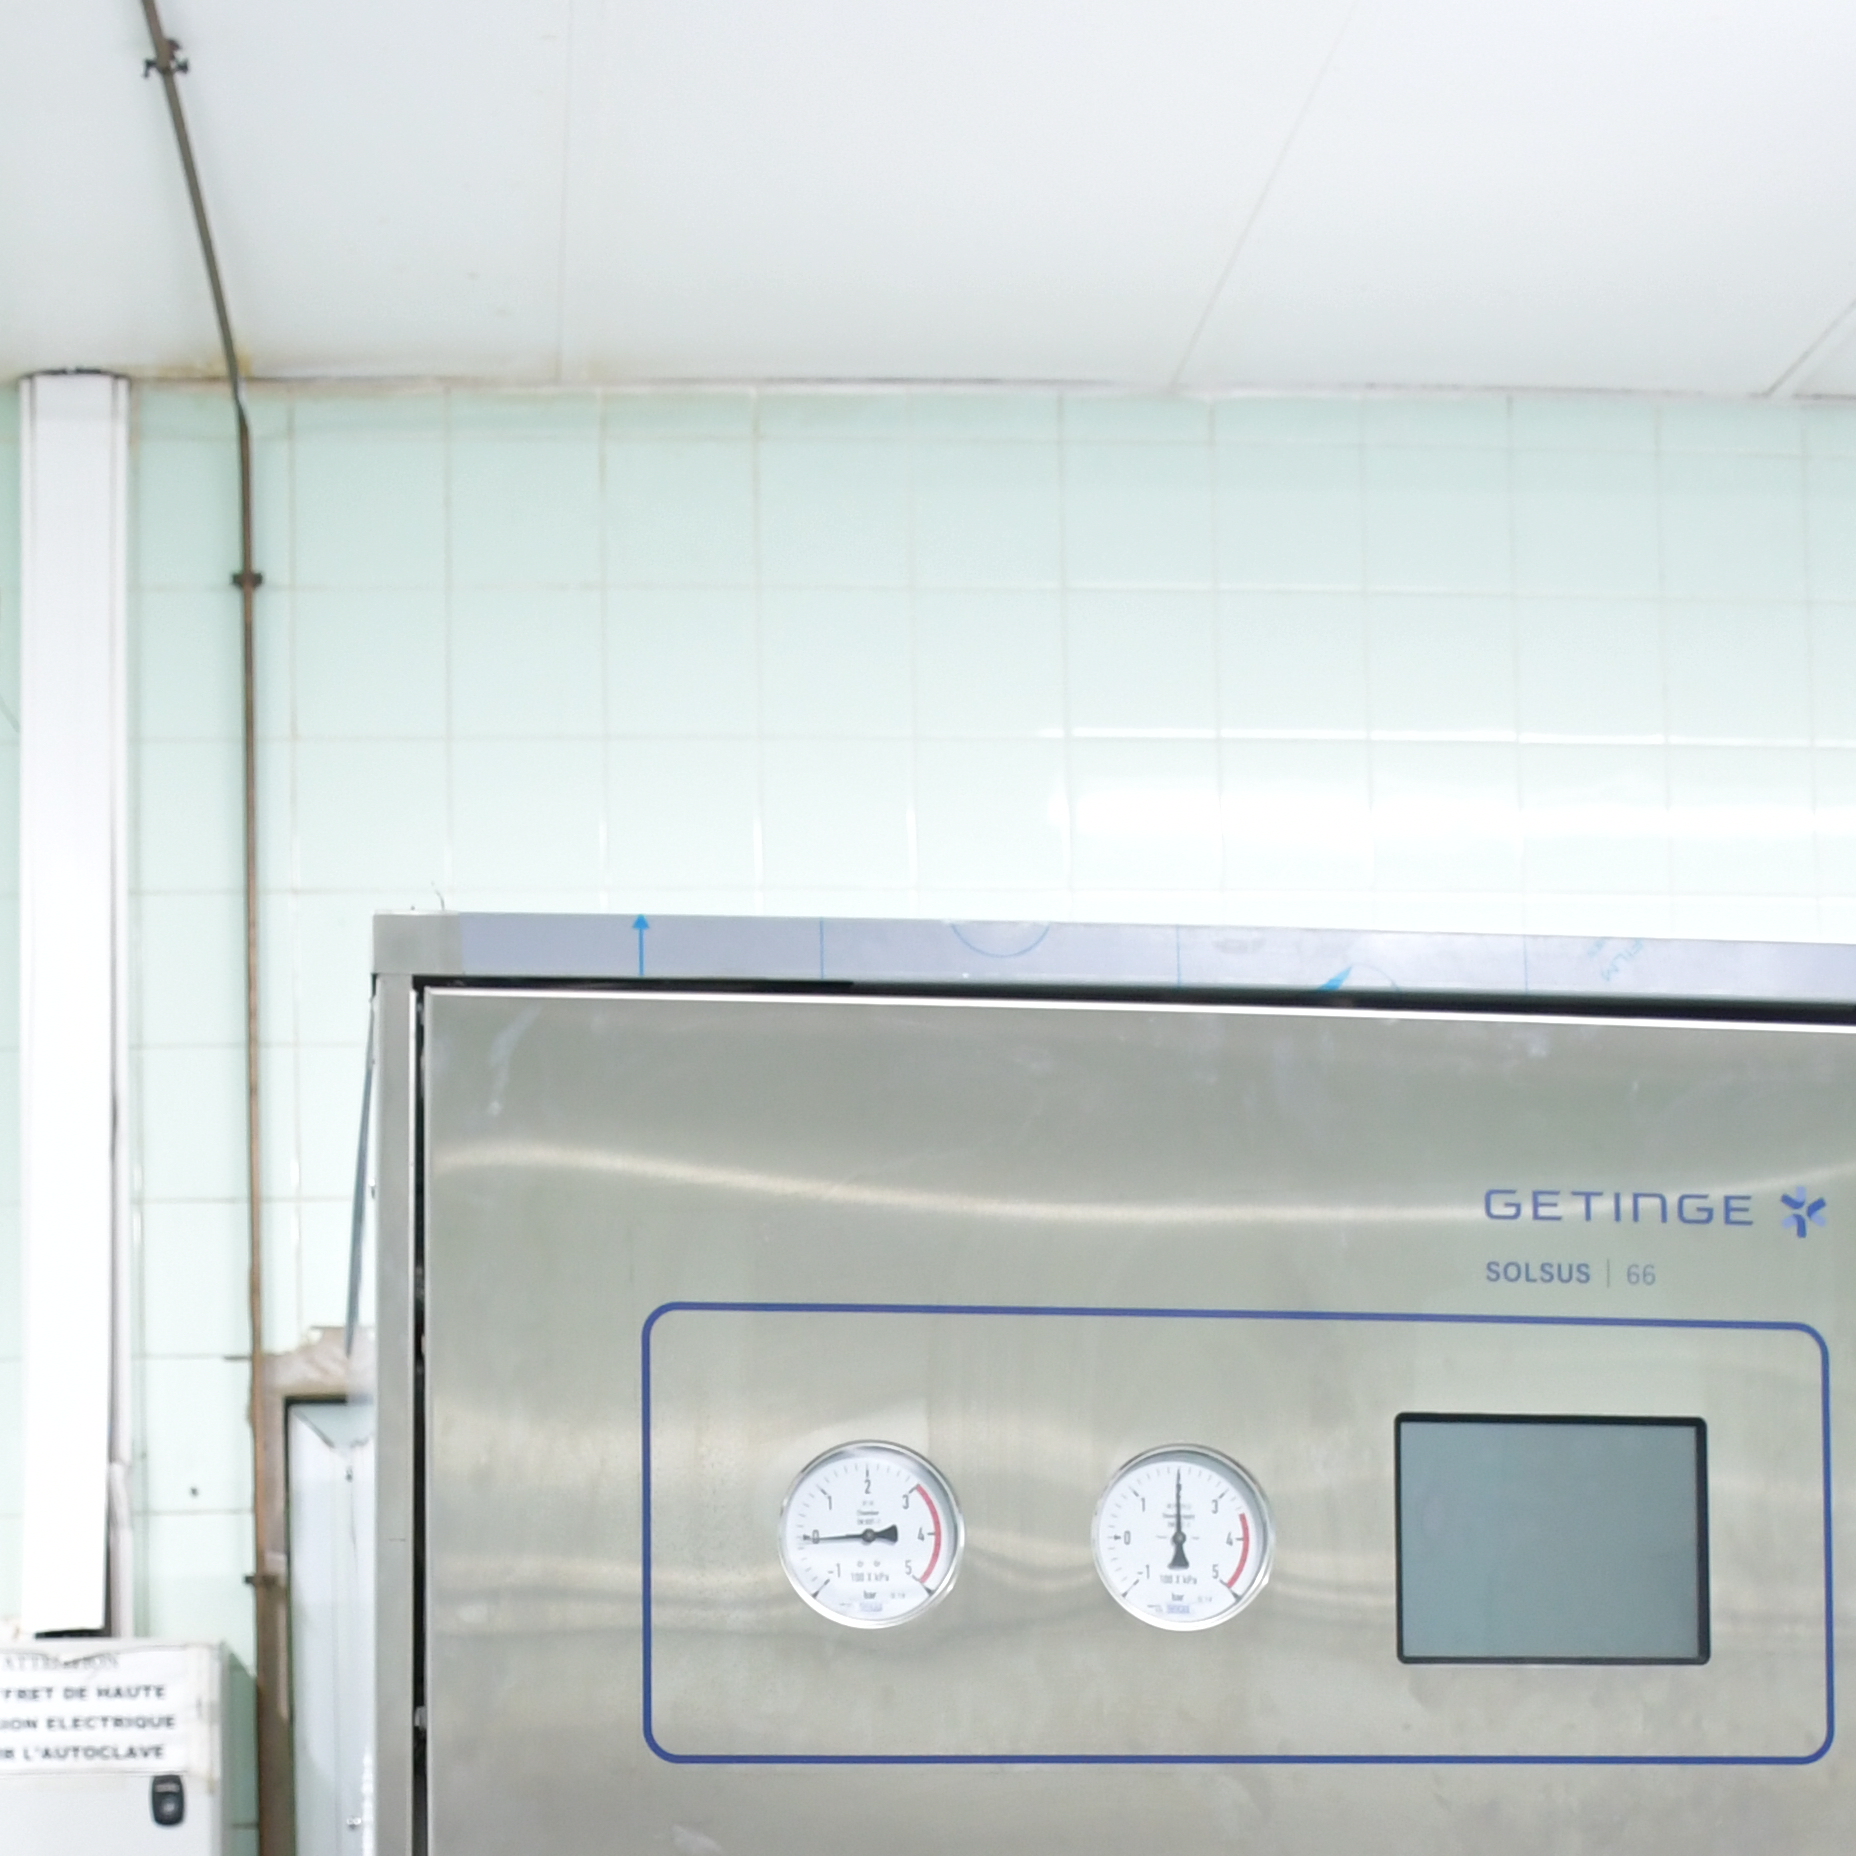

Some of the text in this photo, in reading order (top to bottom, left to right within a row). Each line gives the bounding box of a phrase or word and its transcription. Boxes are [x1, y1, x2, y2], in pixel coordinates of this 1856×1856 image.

[1484, 1188, 1754, 1226] GETINGE
[1485, 1261, 1657, 1286] SOLSUS 66
[864, 1479, 872, 1495] 2
[827, 1495, 833, 1510] 1
[902, 1494, 910, 1510] 3
[1141, 1497, 1146, 1512] 1
[1211, 1499, 1219, 1514] 3
[917, 1527, 925, 1542] 4
[1123, 1530, 1131, 1546] 0
[1226, 1531, 1234, 1547] 4
[905, 1560, 913, 1575] 5
[1212, 1564, 1219, 1579] 5
[63, 1685, 88, 1701] DE
[96, 1683, 167, 1700] HAUTE
[46, 1714, 177, 1731] ELECTRIQUE
[23, 1744, 166, 1762] L'AUTOCLAVE
